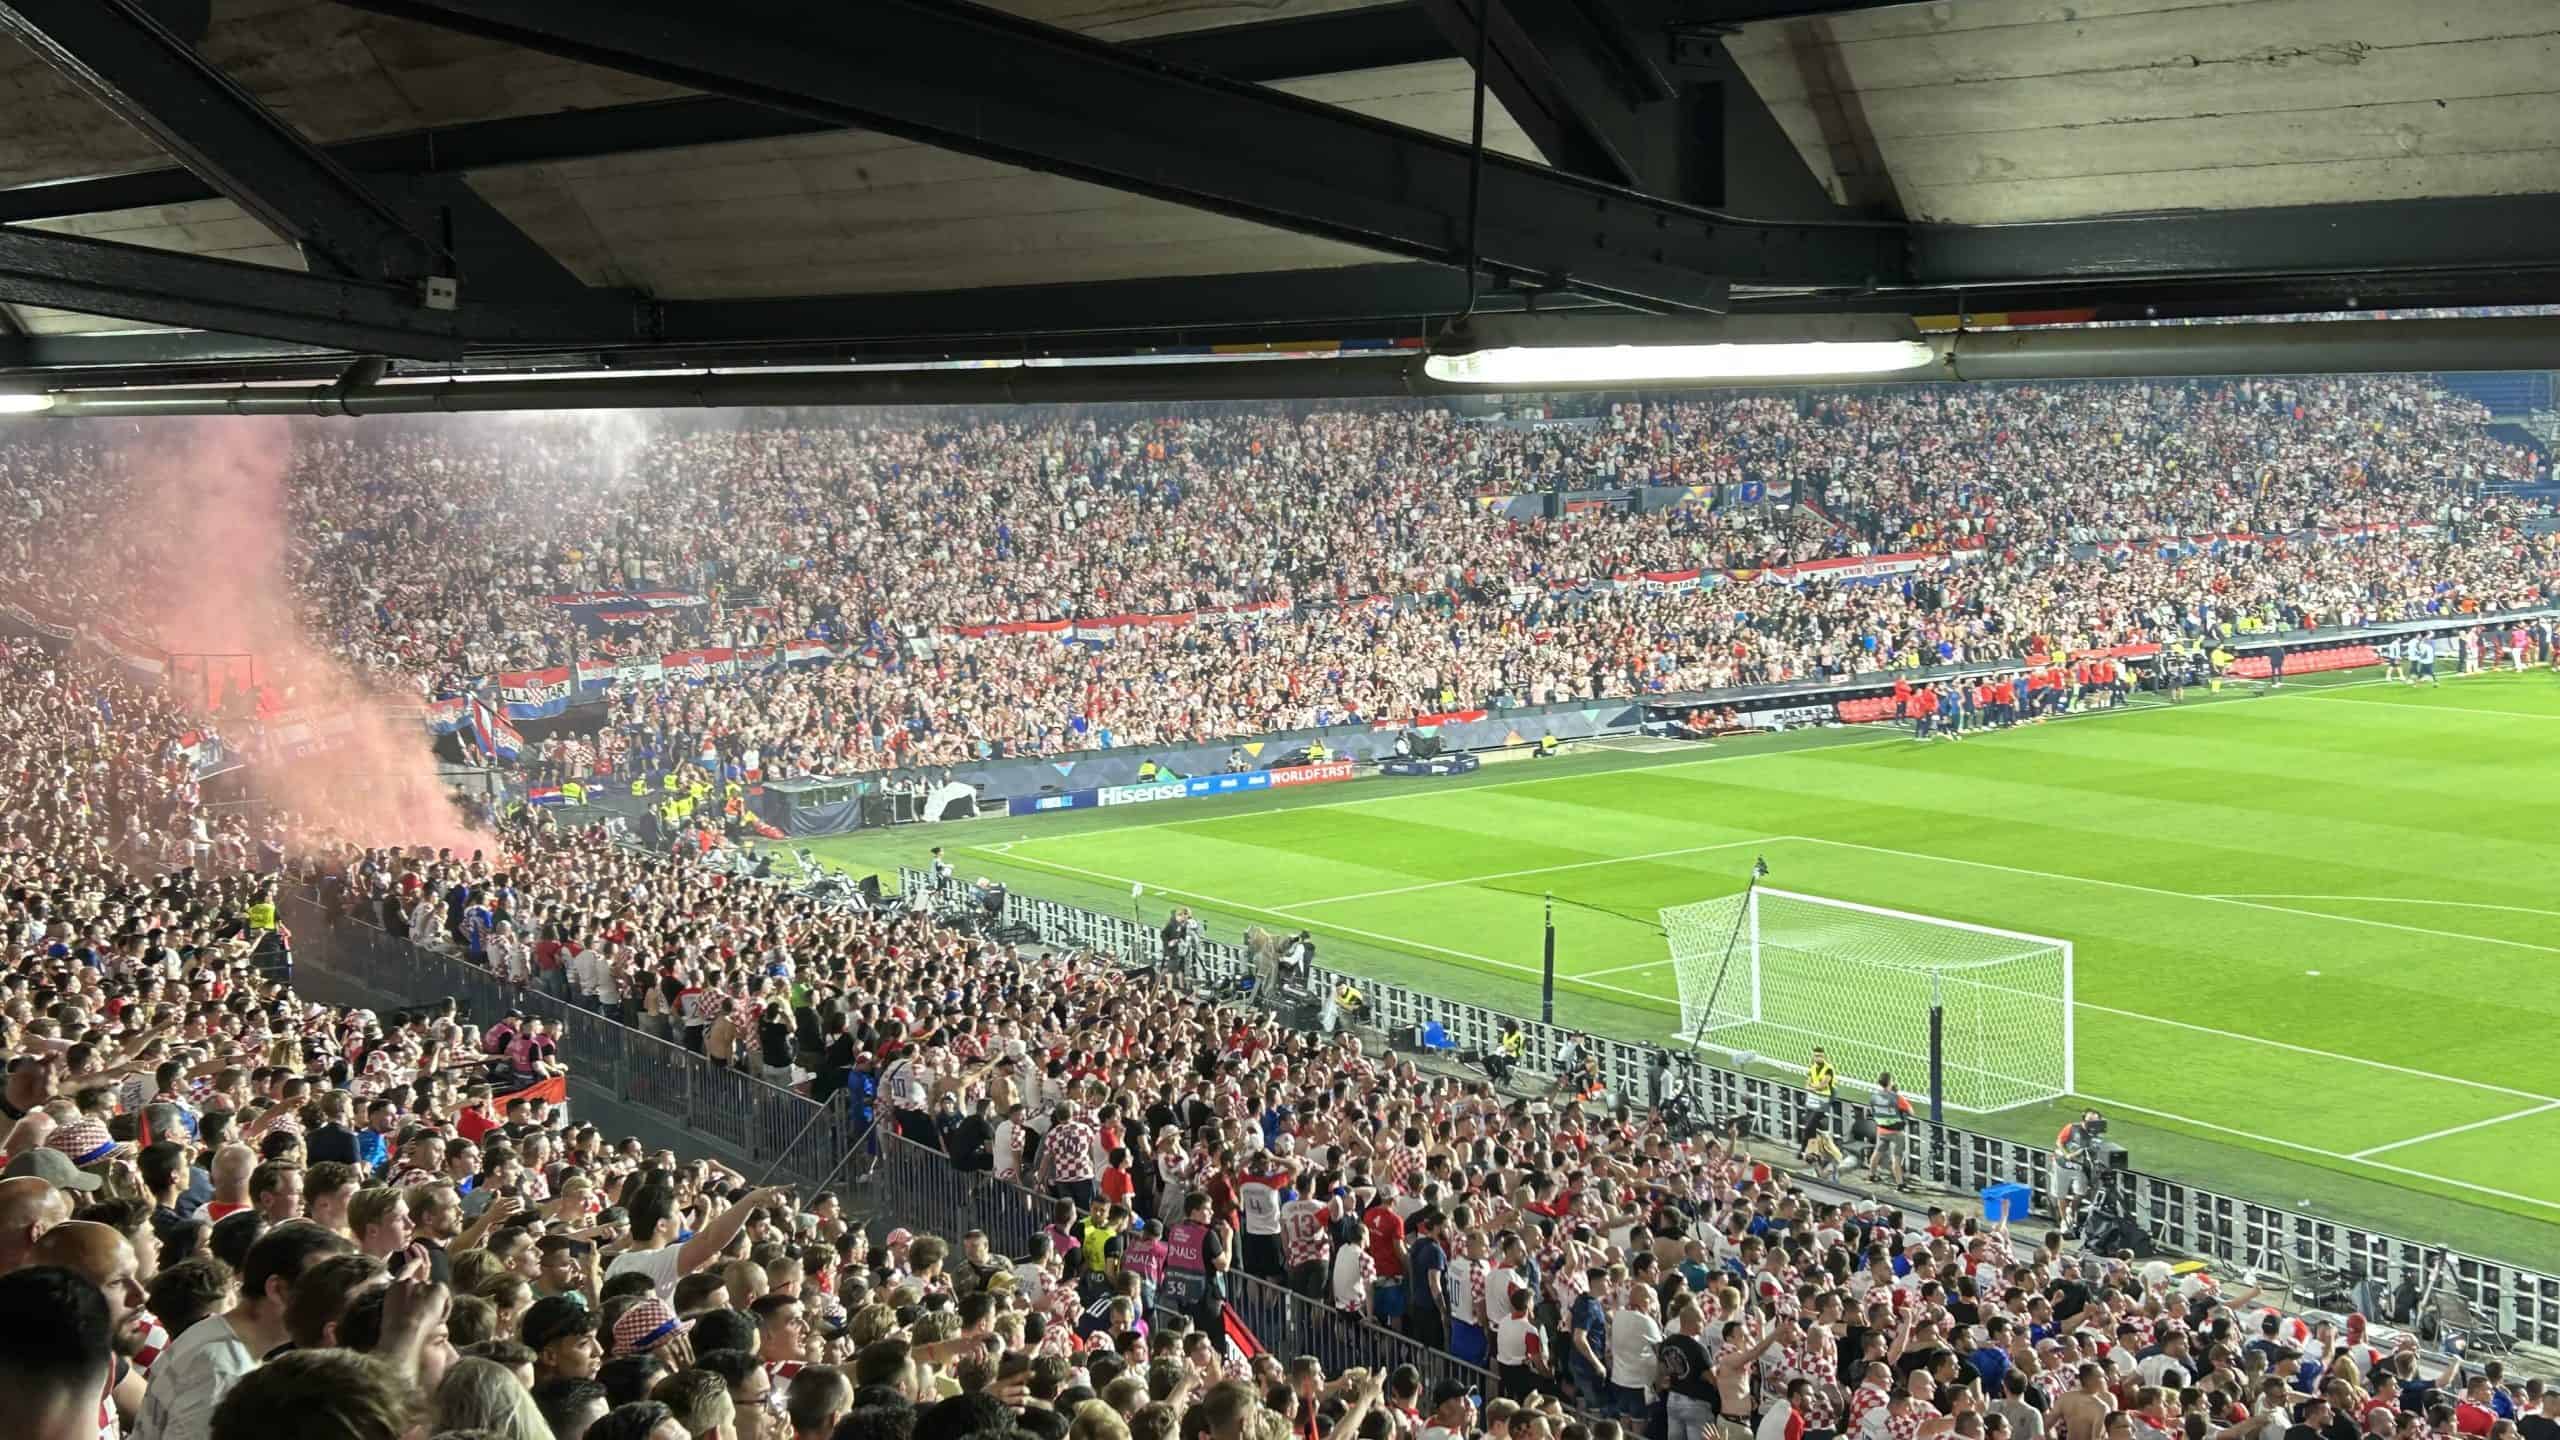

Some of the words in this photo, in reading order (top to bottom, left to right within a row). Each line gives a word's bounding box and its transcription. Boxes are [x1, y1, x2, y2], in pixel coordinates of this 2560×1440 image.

[1271, 764, 1352, 784] WORLDFIRST
[1098, 783, 1187, 806] Hisense
[1291, 1214, 1315, 1237] 13
